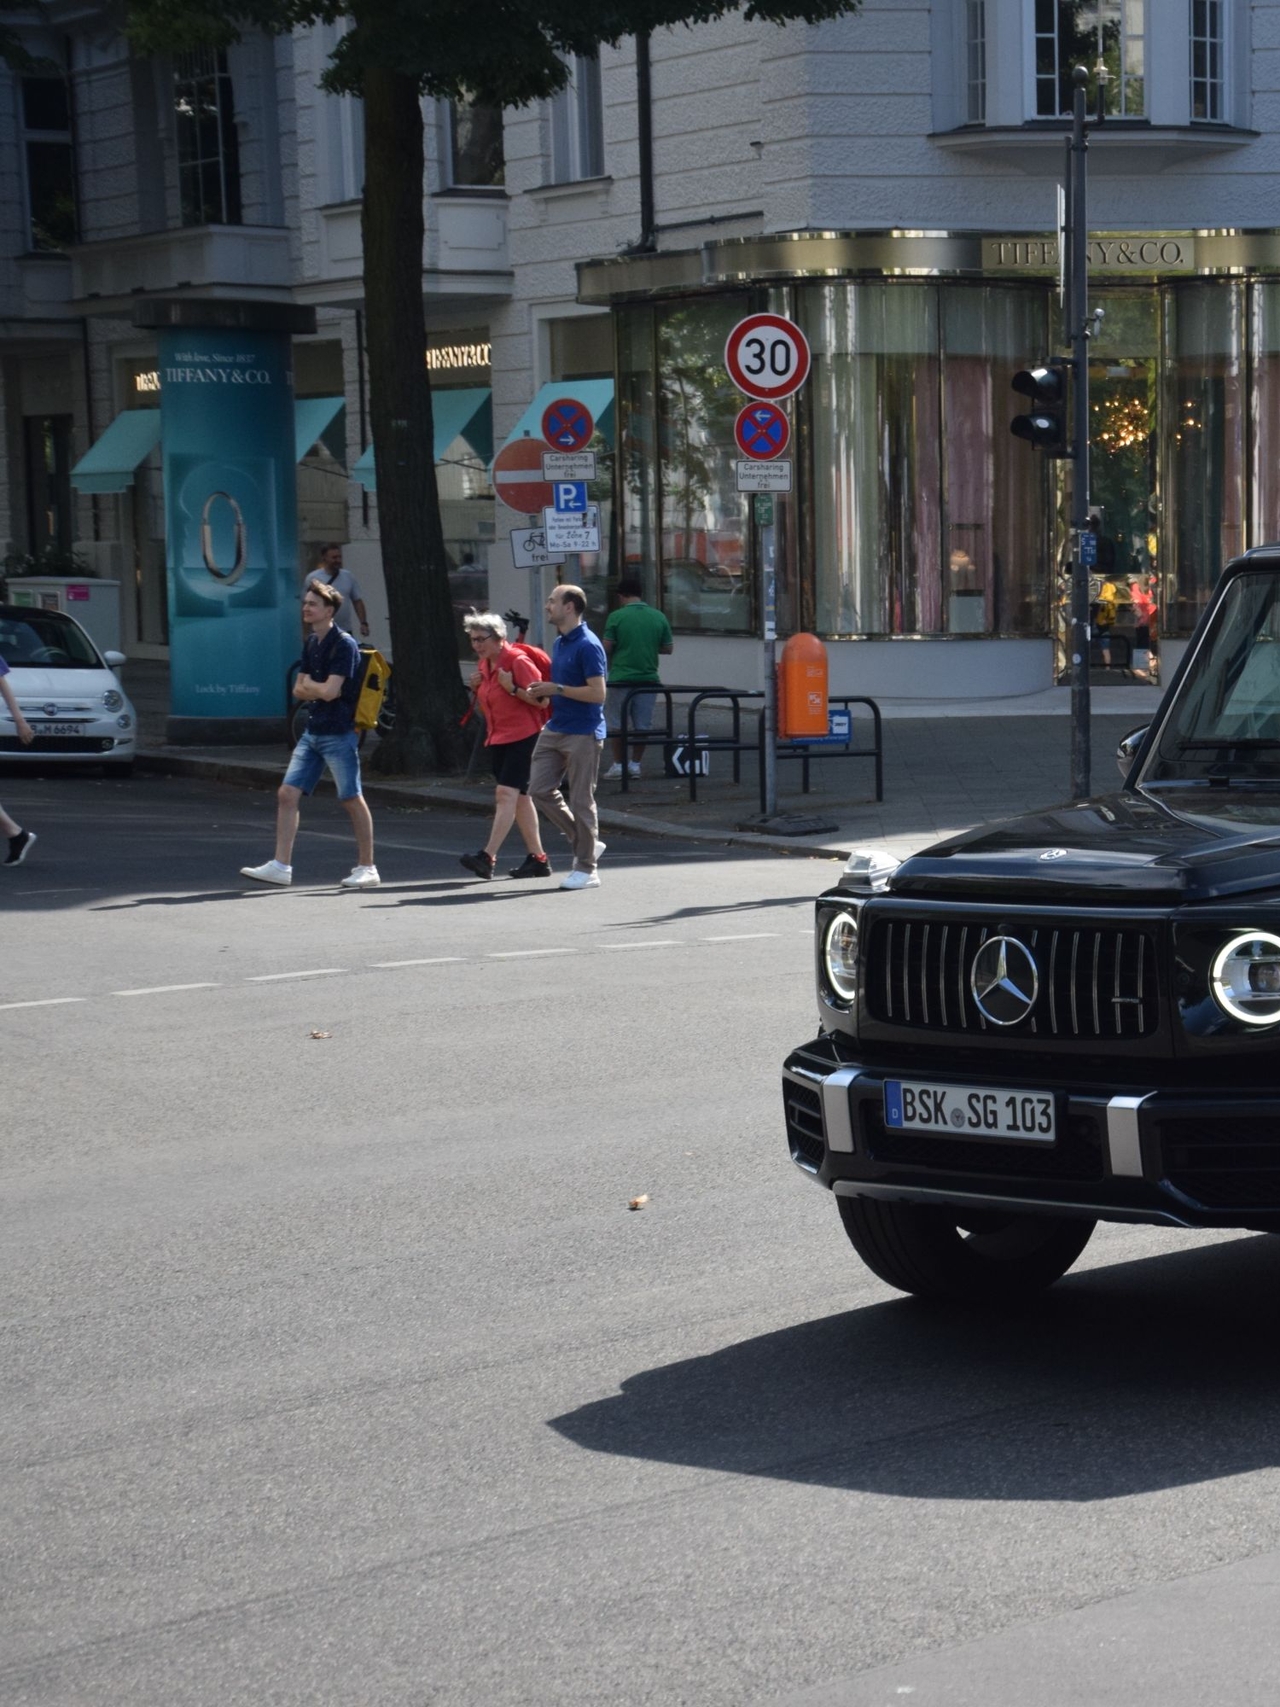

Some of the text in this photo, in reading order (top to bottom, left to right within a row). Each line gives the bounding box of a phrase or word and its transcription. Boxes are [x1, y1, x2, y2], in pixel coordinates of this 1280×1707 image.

[991, 240, 1184, 266] TIFFY&CO.
[212, 353, 234, 363] Since
[744, 338, 791, 376] 30
[546, 463, 593, 471] Unternehmen
[743, 463, 784, 472] Carsharing
[739, 472, 788, 480] Unternehmen
[757, 481, 770, 489] frei
[559, 484, 577, 509] P
[584, 531, 590, 540] 7
[531, 553, 549, 561] frei
[54, 725, 80, 735] 6694
[902, 1088, 948, 1125] BSK
[967, 1093, 998, 1129] SG
[1005, 1096, 1052, 1133] 103
